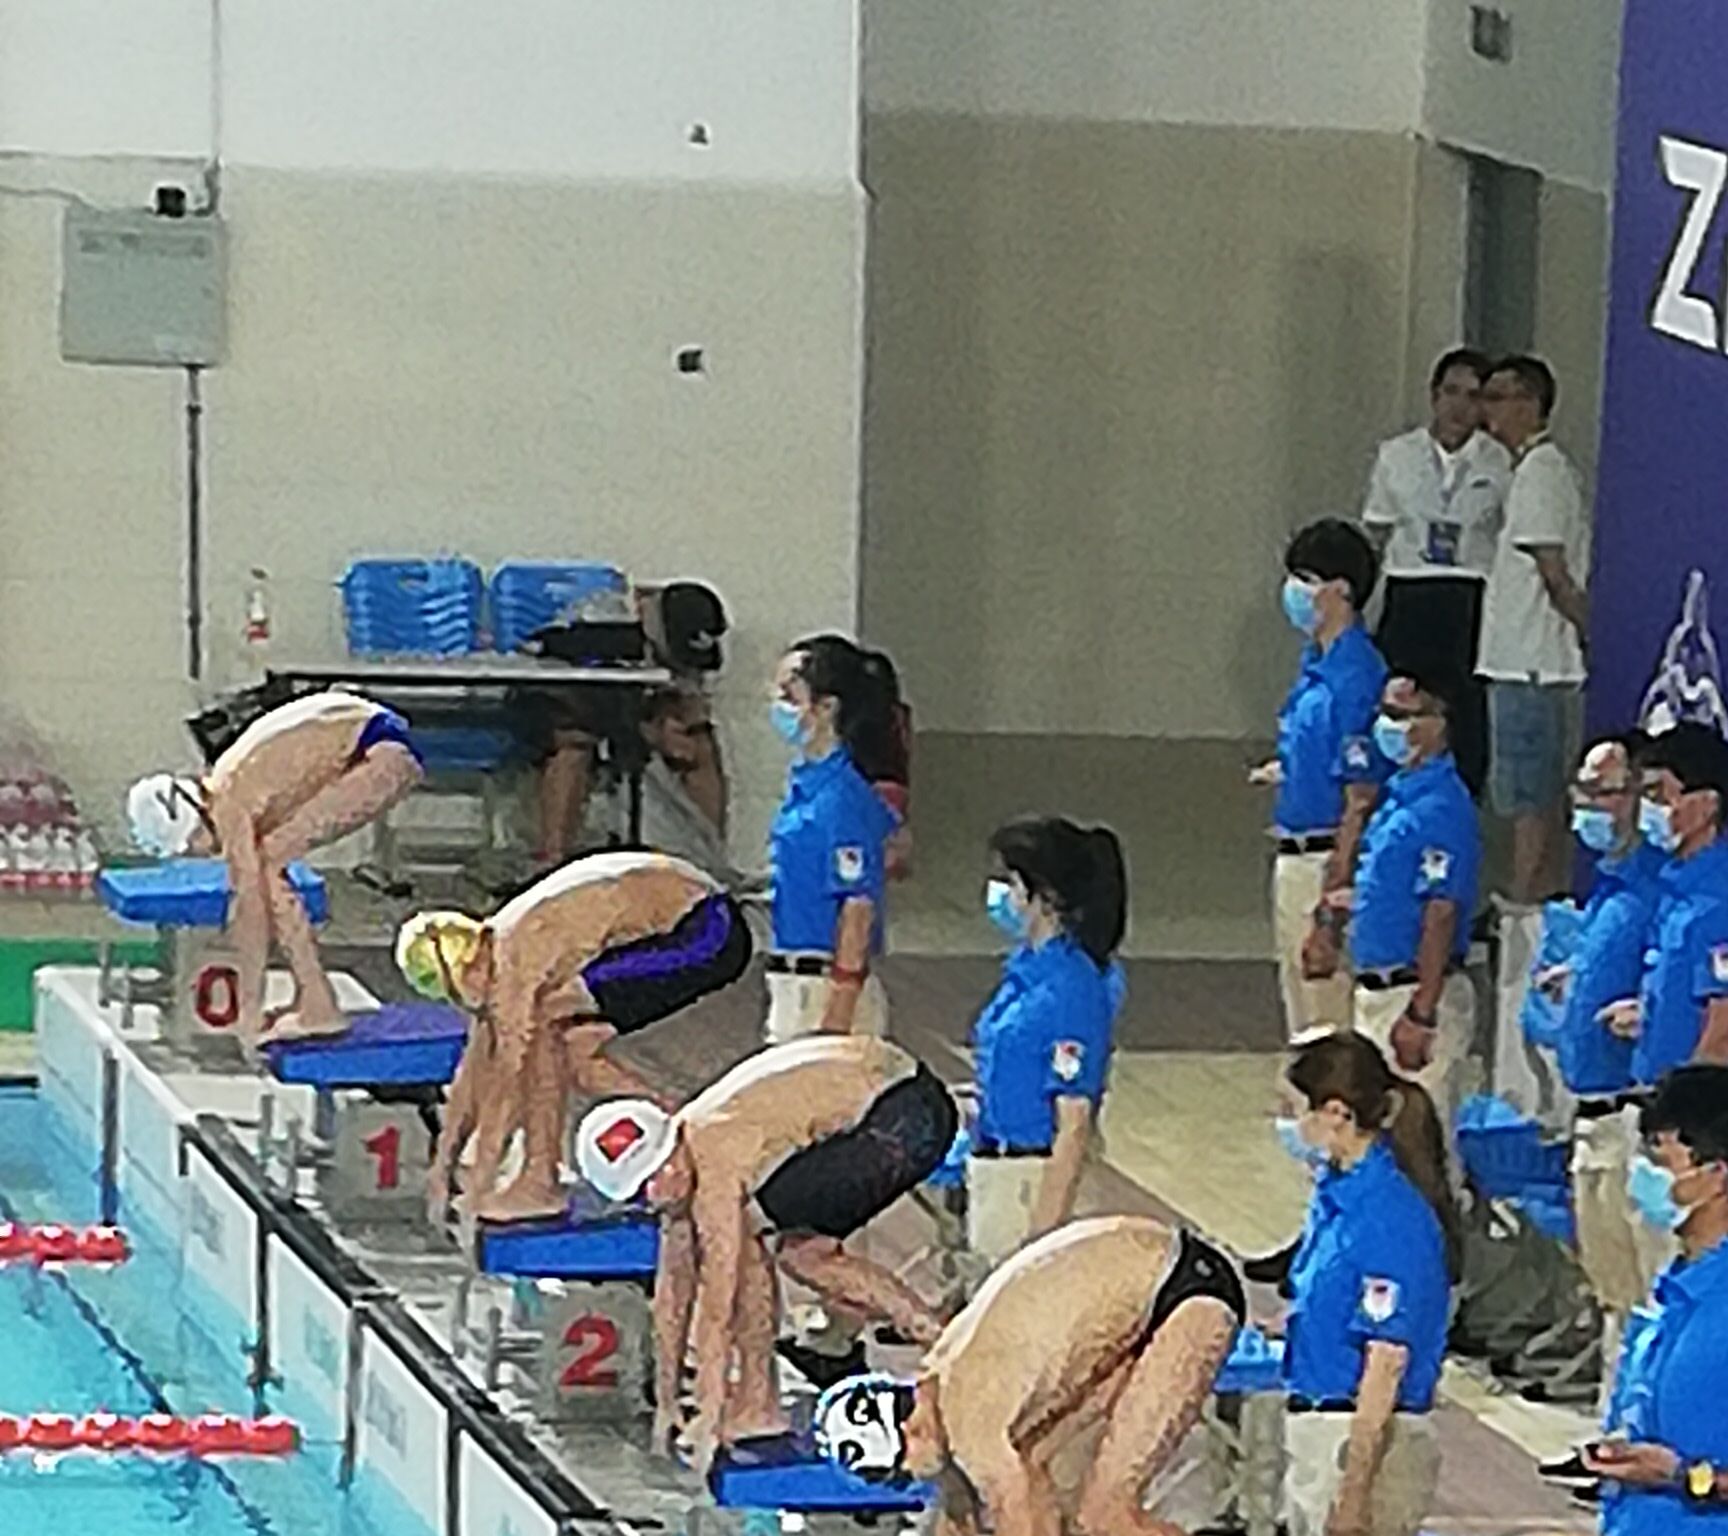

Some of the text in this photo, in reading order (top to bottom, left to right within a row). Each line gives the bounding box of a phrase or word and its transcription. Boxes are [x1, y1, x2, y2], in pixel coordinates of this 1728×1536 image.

[195, 965, 240, 1027] 0
[365, 1125, 401, 1190] 1
[557, 1312, 621, 1389] 2
